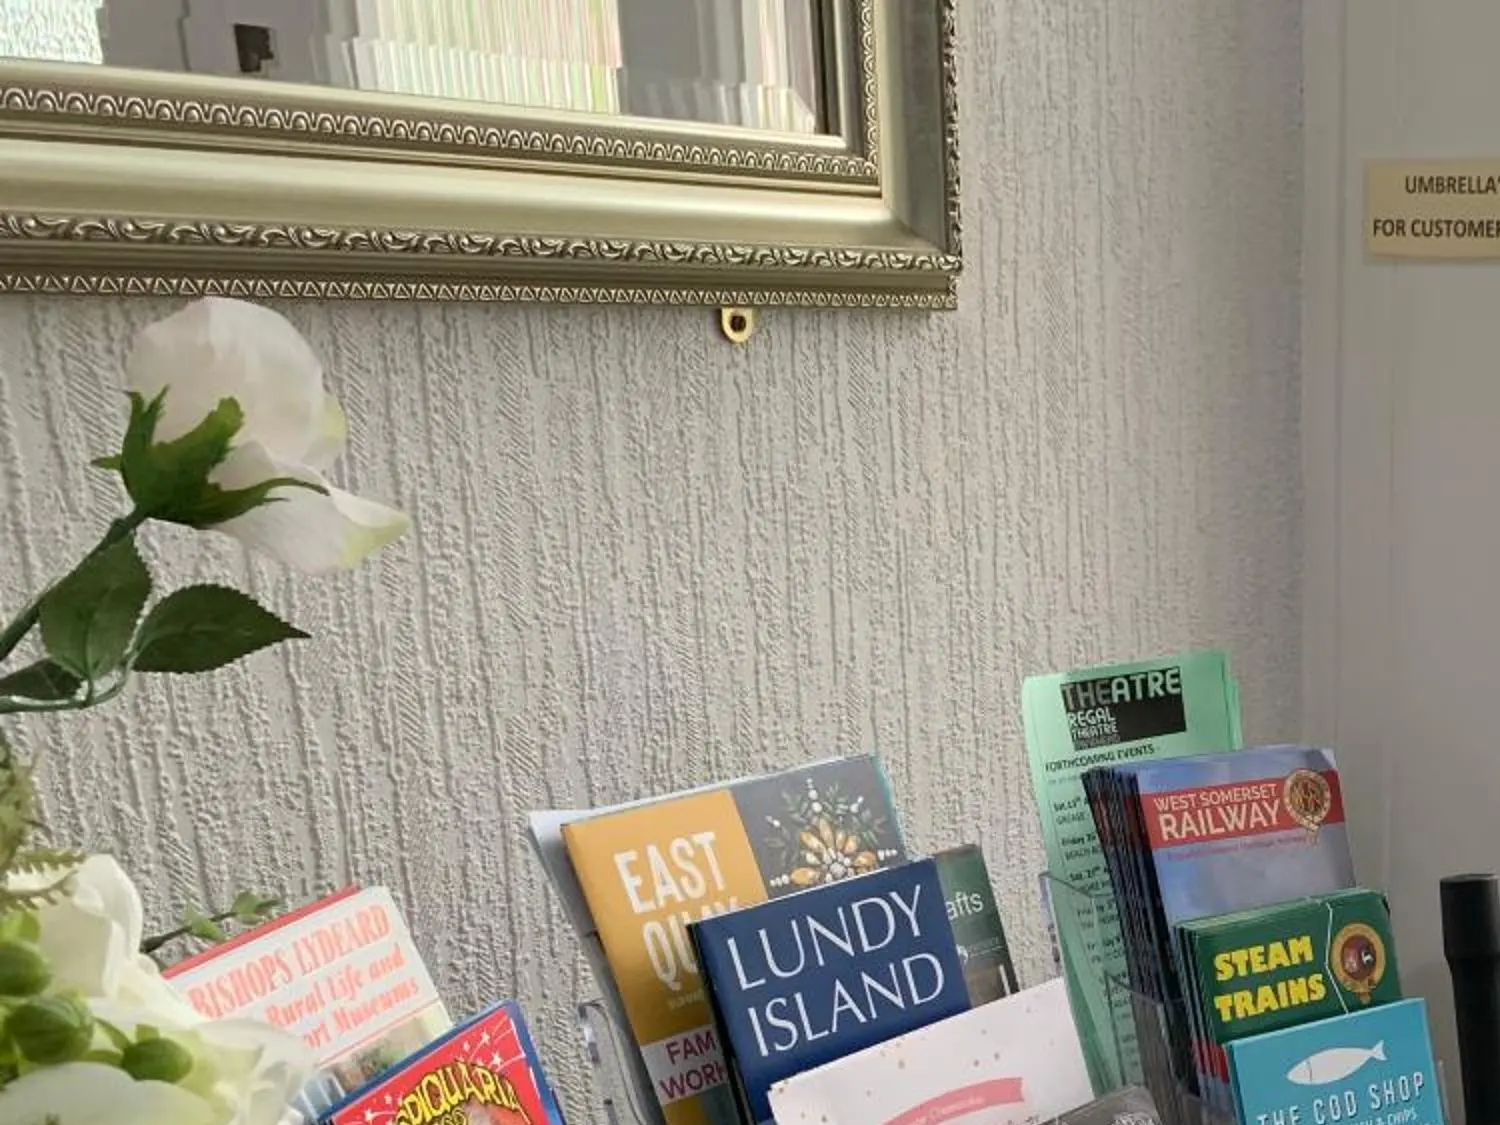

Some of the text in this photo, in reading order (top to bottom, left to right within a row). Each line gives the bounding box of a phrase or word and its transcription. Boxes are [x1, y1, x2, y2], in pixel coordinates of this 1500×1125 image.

[1373, 219, 1406, 237] FOR
[1062, 668, 1181, 710] THEATRE
[1067, 707, 1116, 728] REGAL
[1071, 722, 1119, 740] THEATRE
[1045, 744, 1156, 773] FORTHCOMING EVENTS
[1154, 783, 1277, 812] WEST SOMERSET
[1159, 799, 1281, 842] RAILWAY
[613, 831, 726, 914] EAST
[727, 884, 921, 991] LUNDY
[1214, 935, 1314, 981] STEAM
[188, 903, 391, 1020] BISHOPS LYDEARD
[264, 943, 406, 1029] Rural Life and
[747, 953, 945, 1057] ISLAND
[1214, 973, 1326, 1023] TRAINS
[1313, 1090, 1358, 1125] COD
[1369, 1071, 1425, 1110] SHOP
